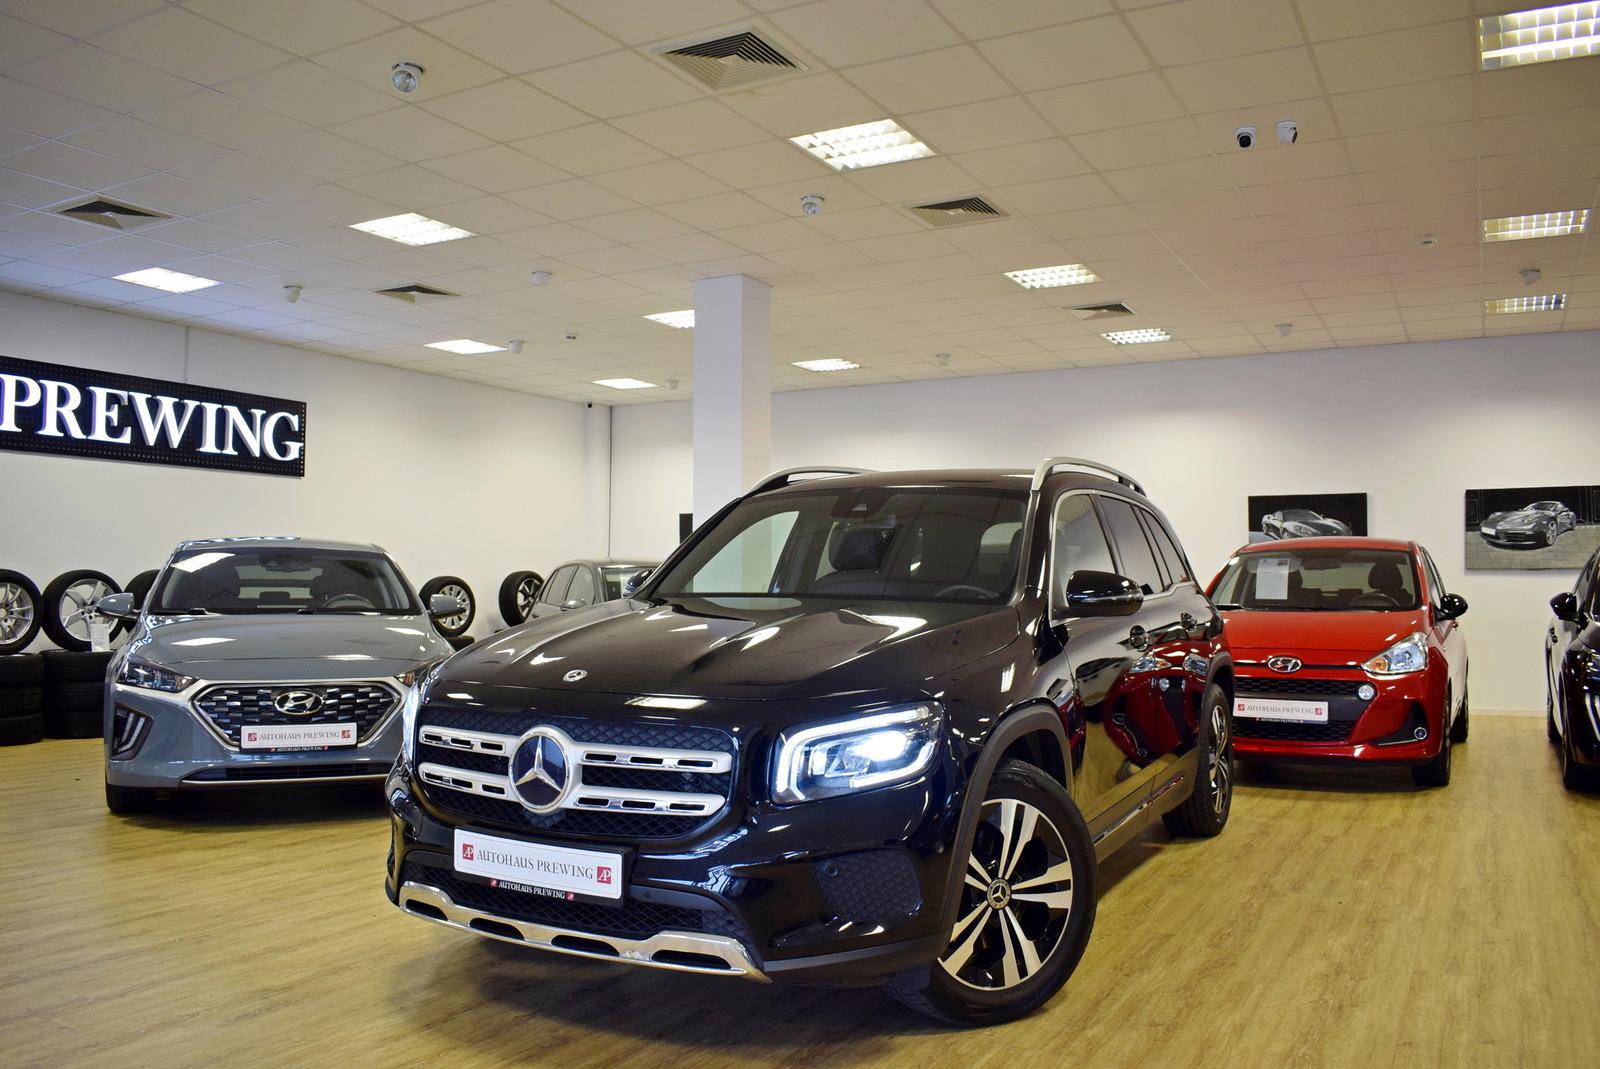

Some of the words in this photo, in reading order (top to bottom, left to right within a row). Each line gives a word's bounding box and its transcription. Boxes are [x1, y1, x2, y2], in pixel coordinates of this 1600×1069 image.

[0, 373, 304, 461] PREWING
[260, 732, 302, 740] AUTOHAUS
[303, 731, 340, 739] PREWING
[477, 849, 534, 870] AUTOHAUS
[537, 860, 593, 879] PREWING
[499, 881, 533, 894] AUTOHAUS
[533, 887, 566, 899] PREWING
